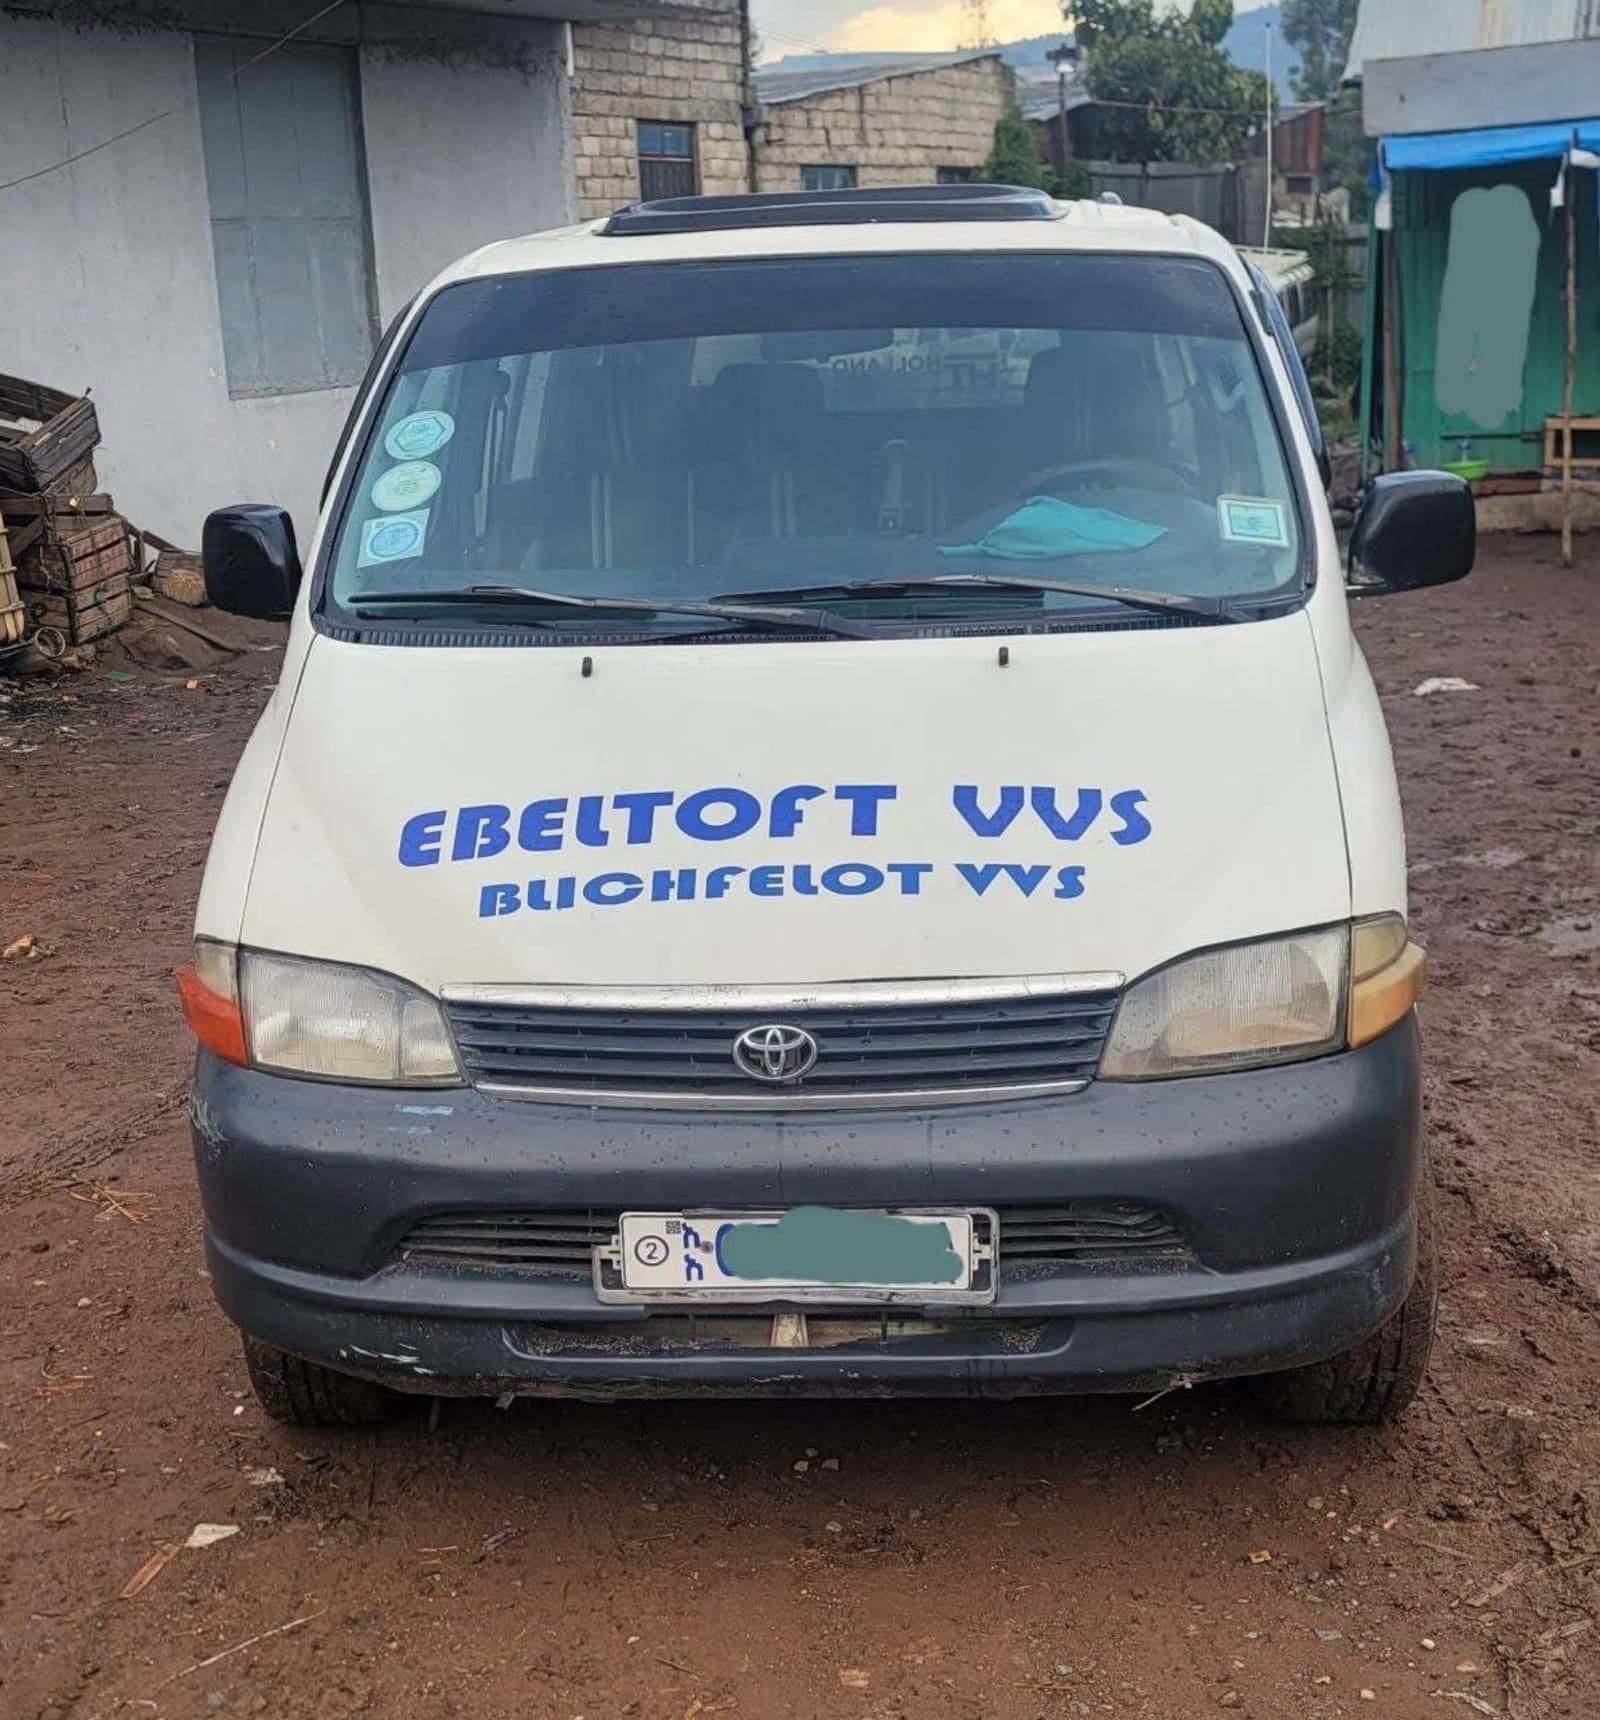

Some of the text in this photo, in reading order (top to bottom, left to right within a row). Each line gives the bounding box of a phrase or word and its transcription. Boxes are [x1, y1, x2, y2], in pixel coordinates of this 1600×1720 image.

[398, 784, 1152, 867] EBELTOFT VVS
[479, 862, 1085, 917] BLICHFELOT VVS
